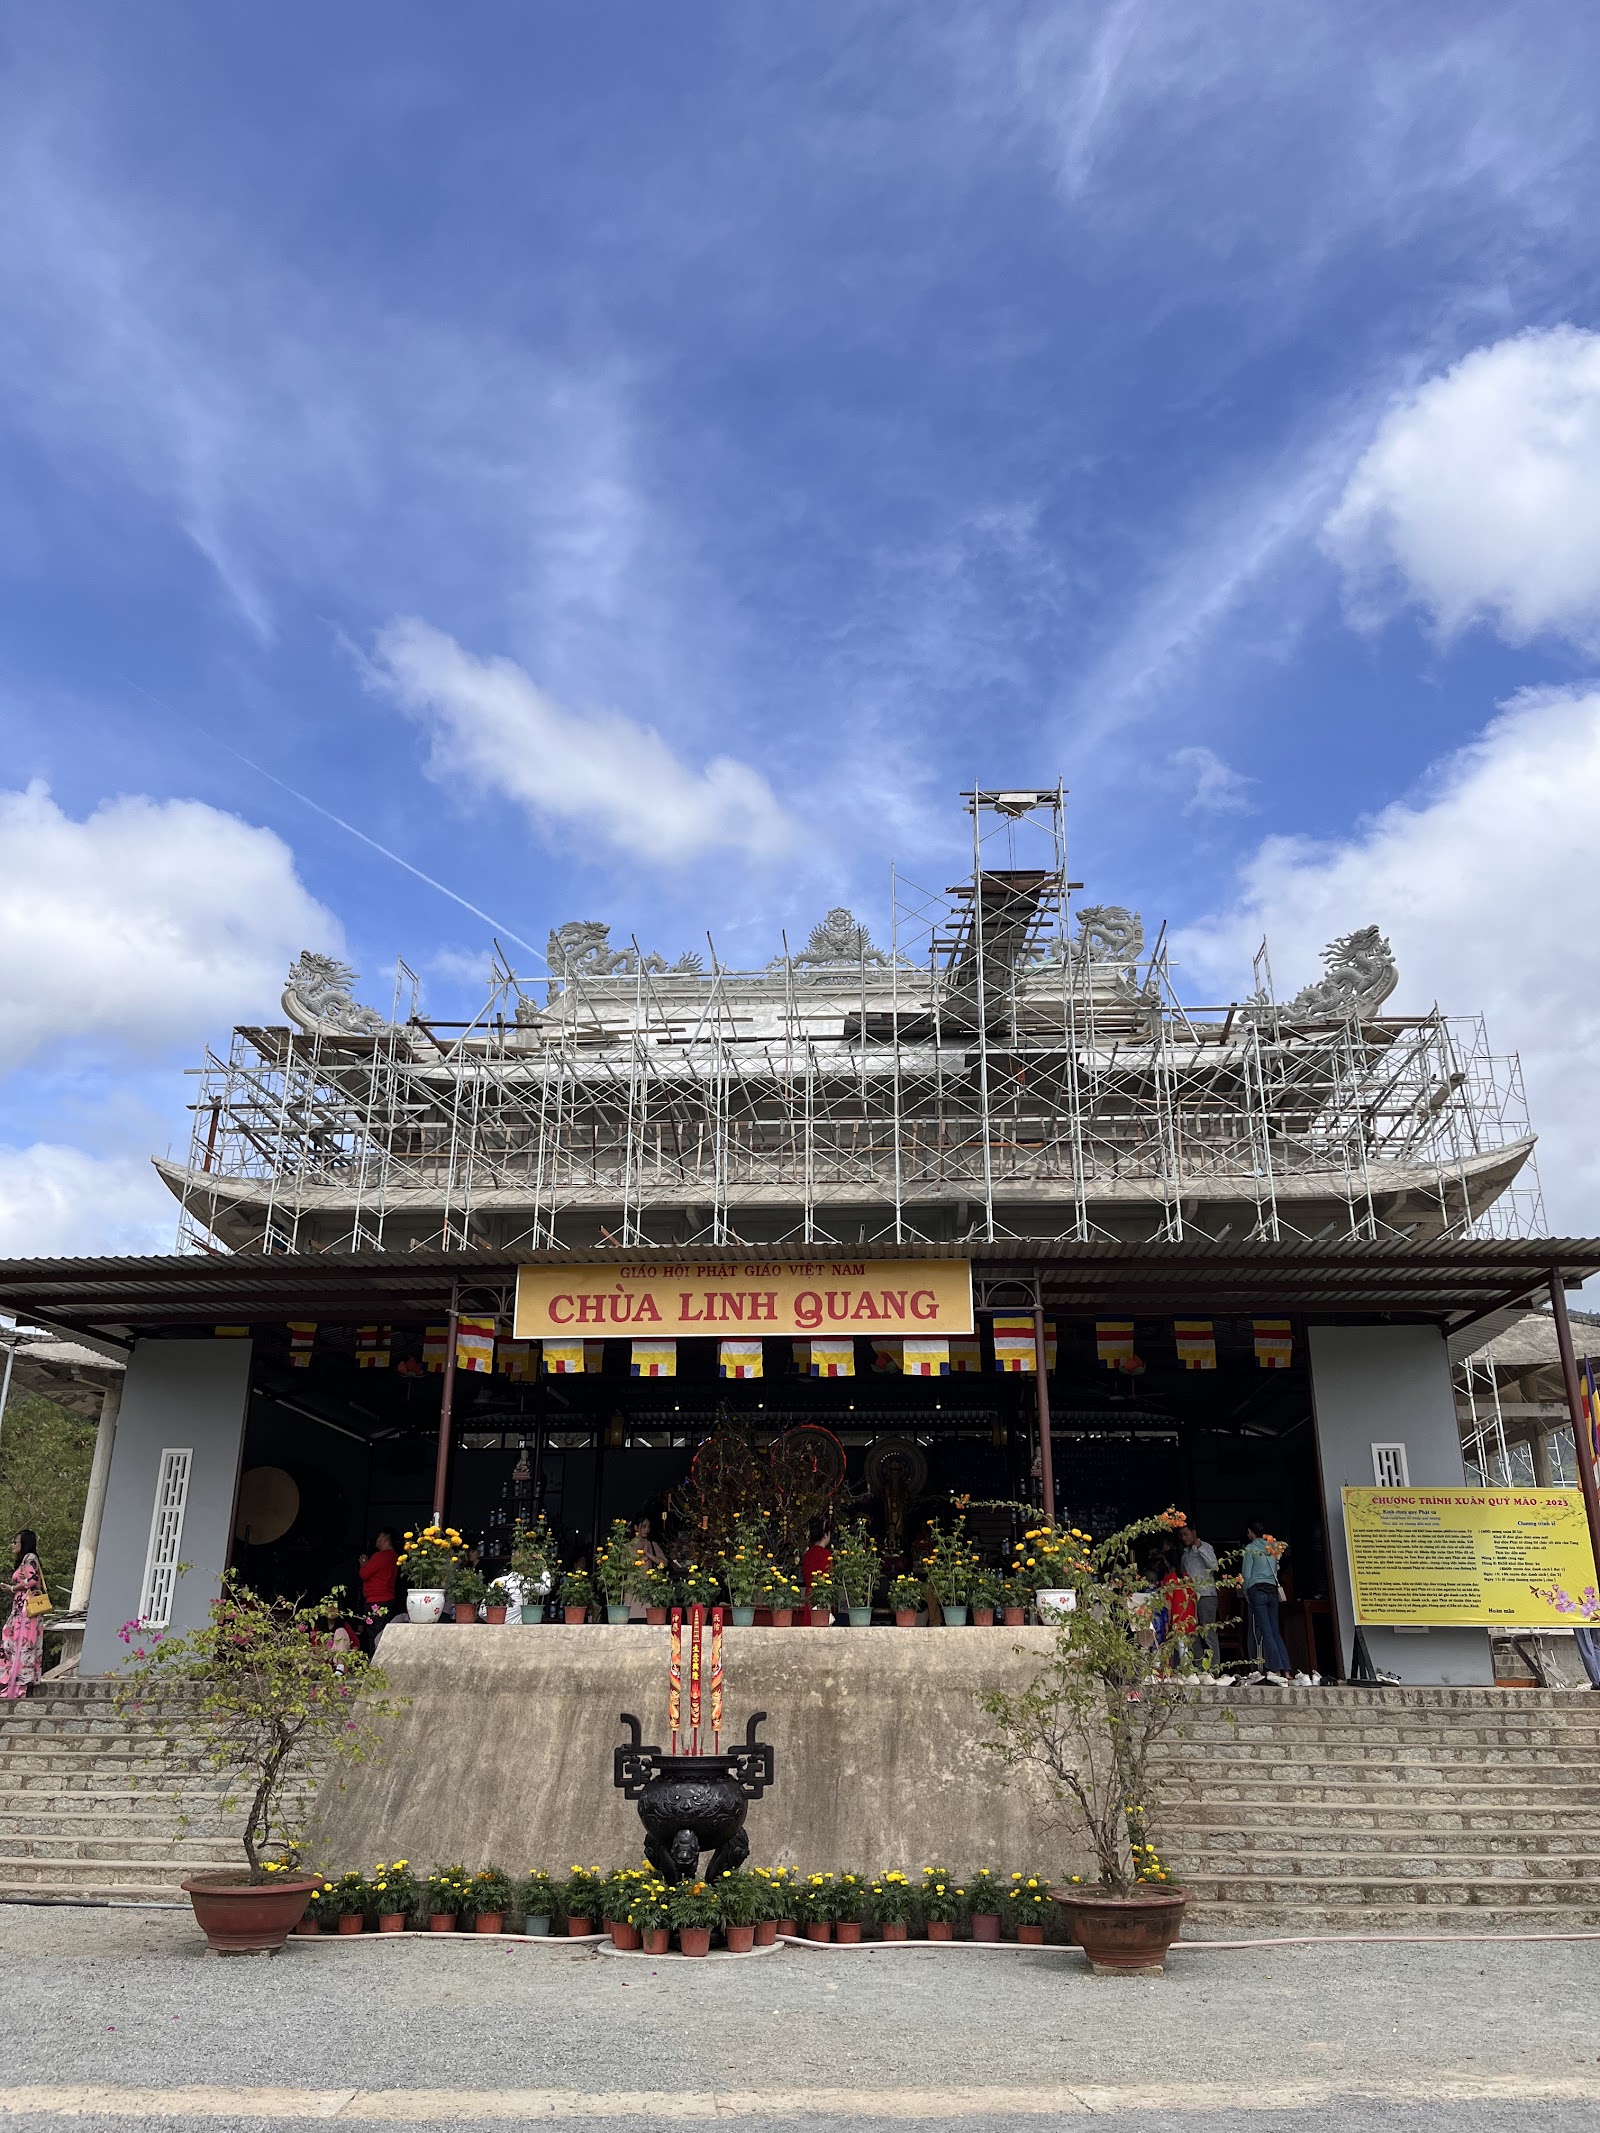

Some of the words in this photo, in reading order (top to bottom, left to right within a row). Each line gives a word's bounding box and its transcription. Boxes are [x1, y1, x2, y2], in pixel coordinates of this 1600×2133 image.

[620, 1264, 657, 1278] GIÁO
[662, 1263, 690, 1280] HỘI
[696, 1263, 738, 1280] PHẬT
[744, 1262, 782, 1277] GIÁO
[788, 1262, 826, 1279] VIỆT
[831, 1263, 866, 1276] NAM
[548, 1283, 663, 1323] CHÙA
[678, 1291, 779, 1321] LINH
[794, 1290, 940, 1329] QUANG
[1372, 1495, 1416, 1505] CHƯƠNG
[1419, 1495, 1452, 1505] TRÌNH
[1455, 1495, 1485, 1505] XUÂN
[1488, 1496, 1510, 1506] QUÝ
[1514, 1497, 1537, 1506] MÃO
[1546, 1499, 1569, 1507] 2023
